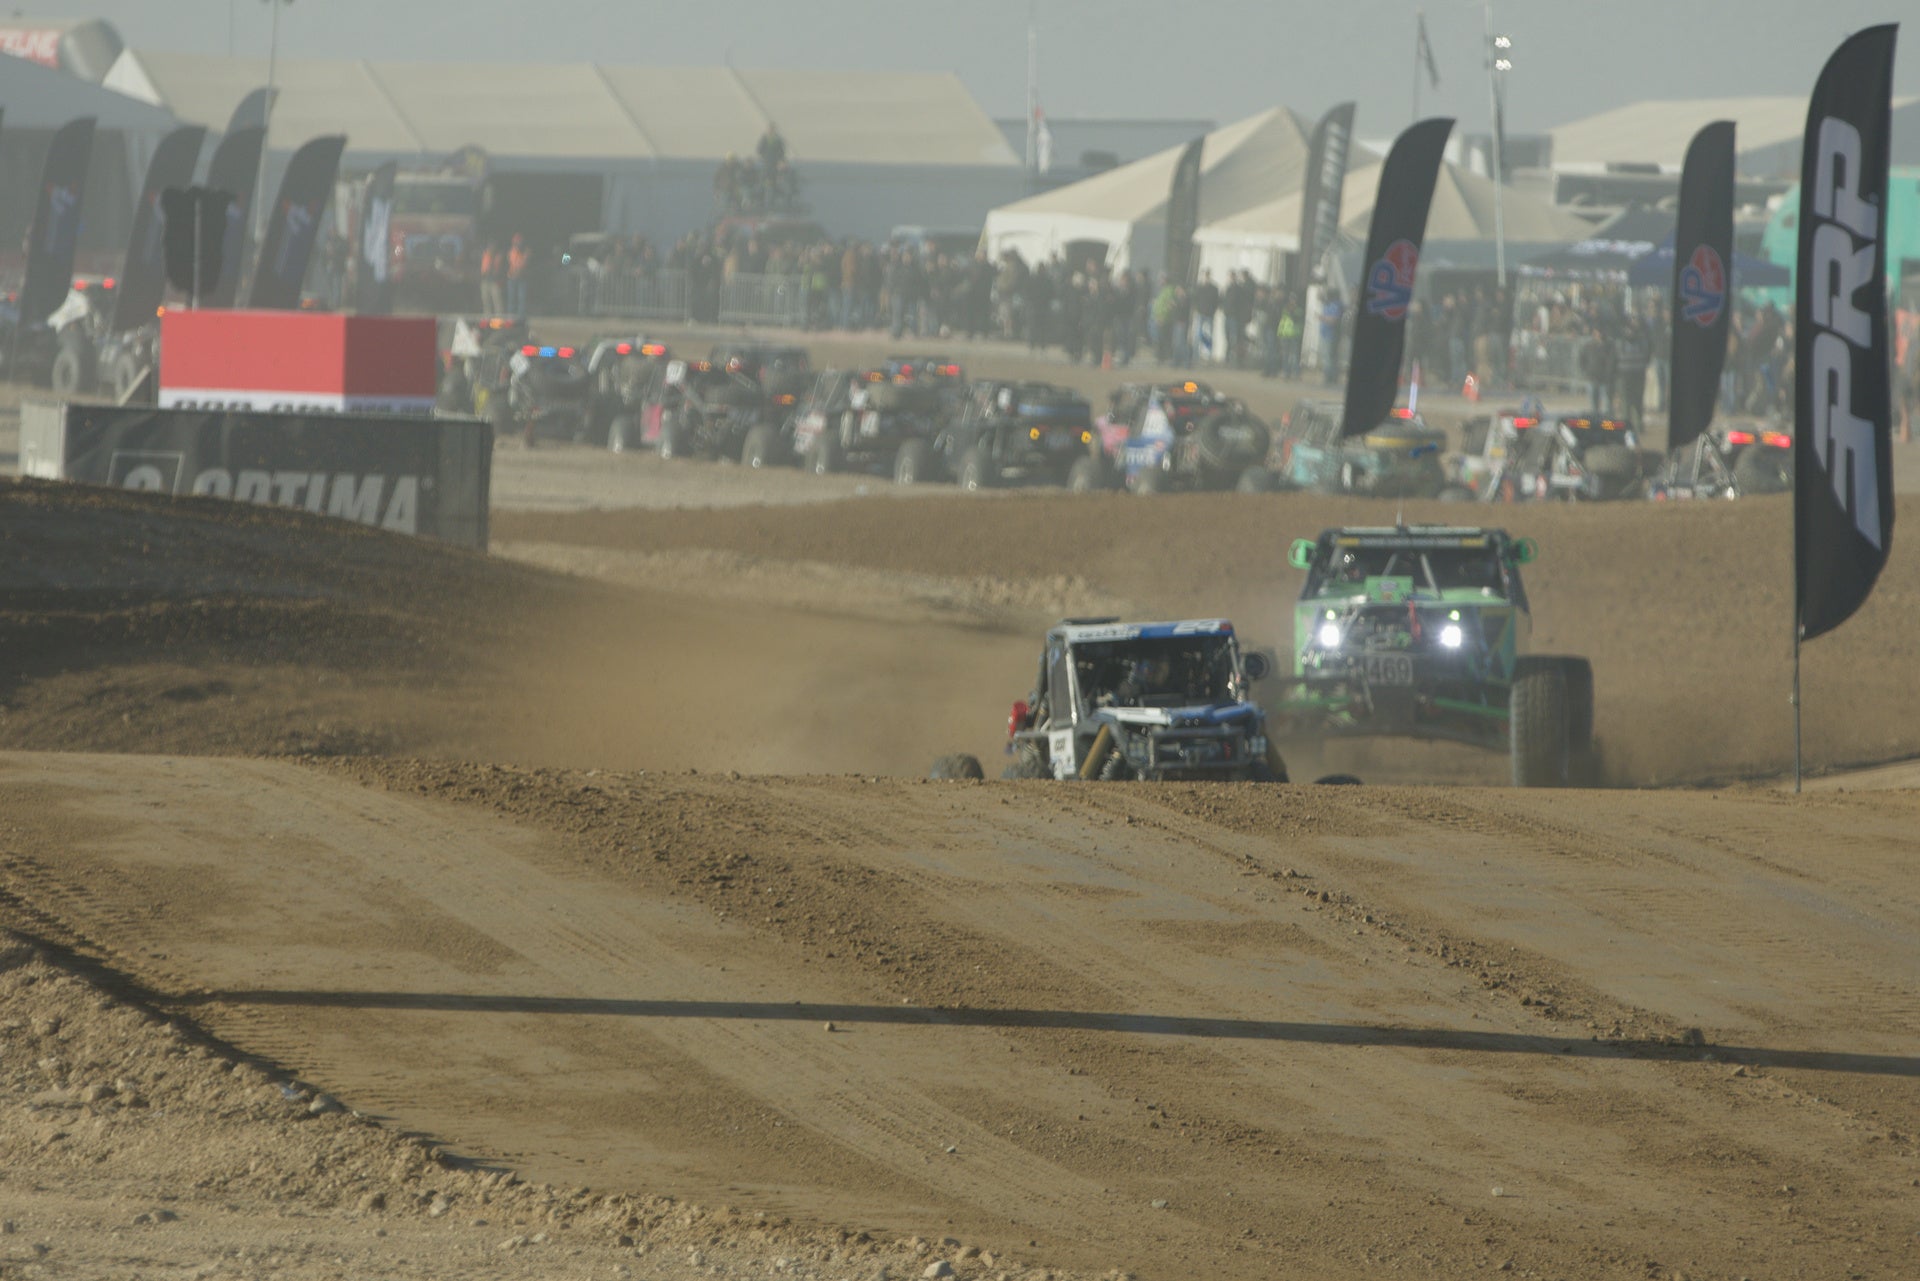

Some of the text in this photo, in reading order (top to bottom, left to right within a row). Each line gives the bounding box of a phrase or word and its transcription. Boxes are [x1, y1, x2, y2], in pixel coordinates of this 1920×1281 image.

[1366, 258, 1413, 315] VP
[1680, 264, 1724, 320] VP
[1812, 116, 1882, 550] PRP
